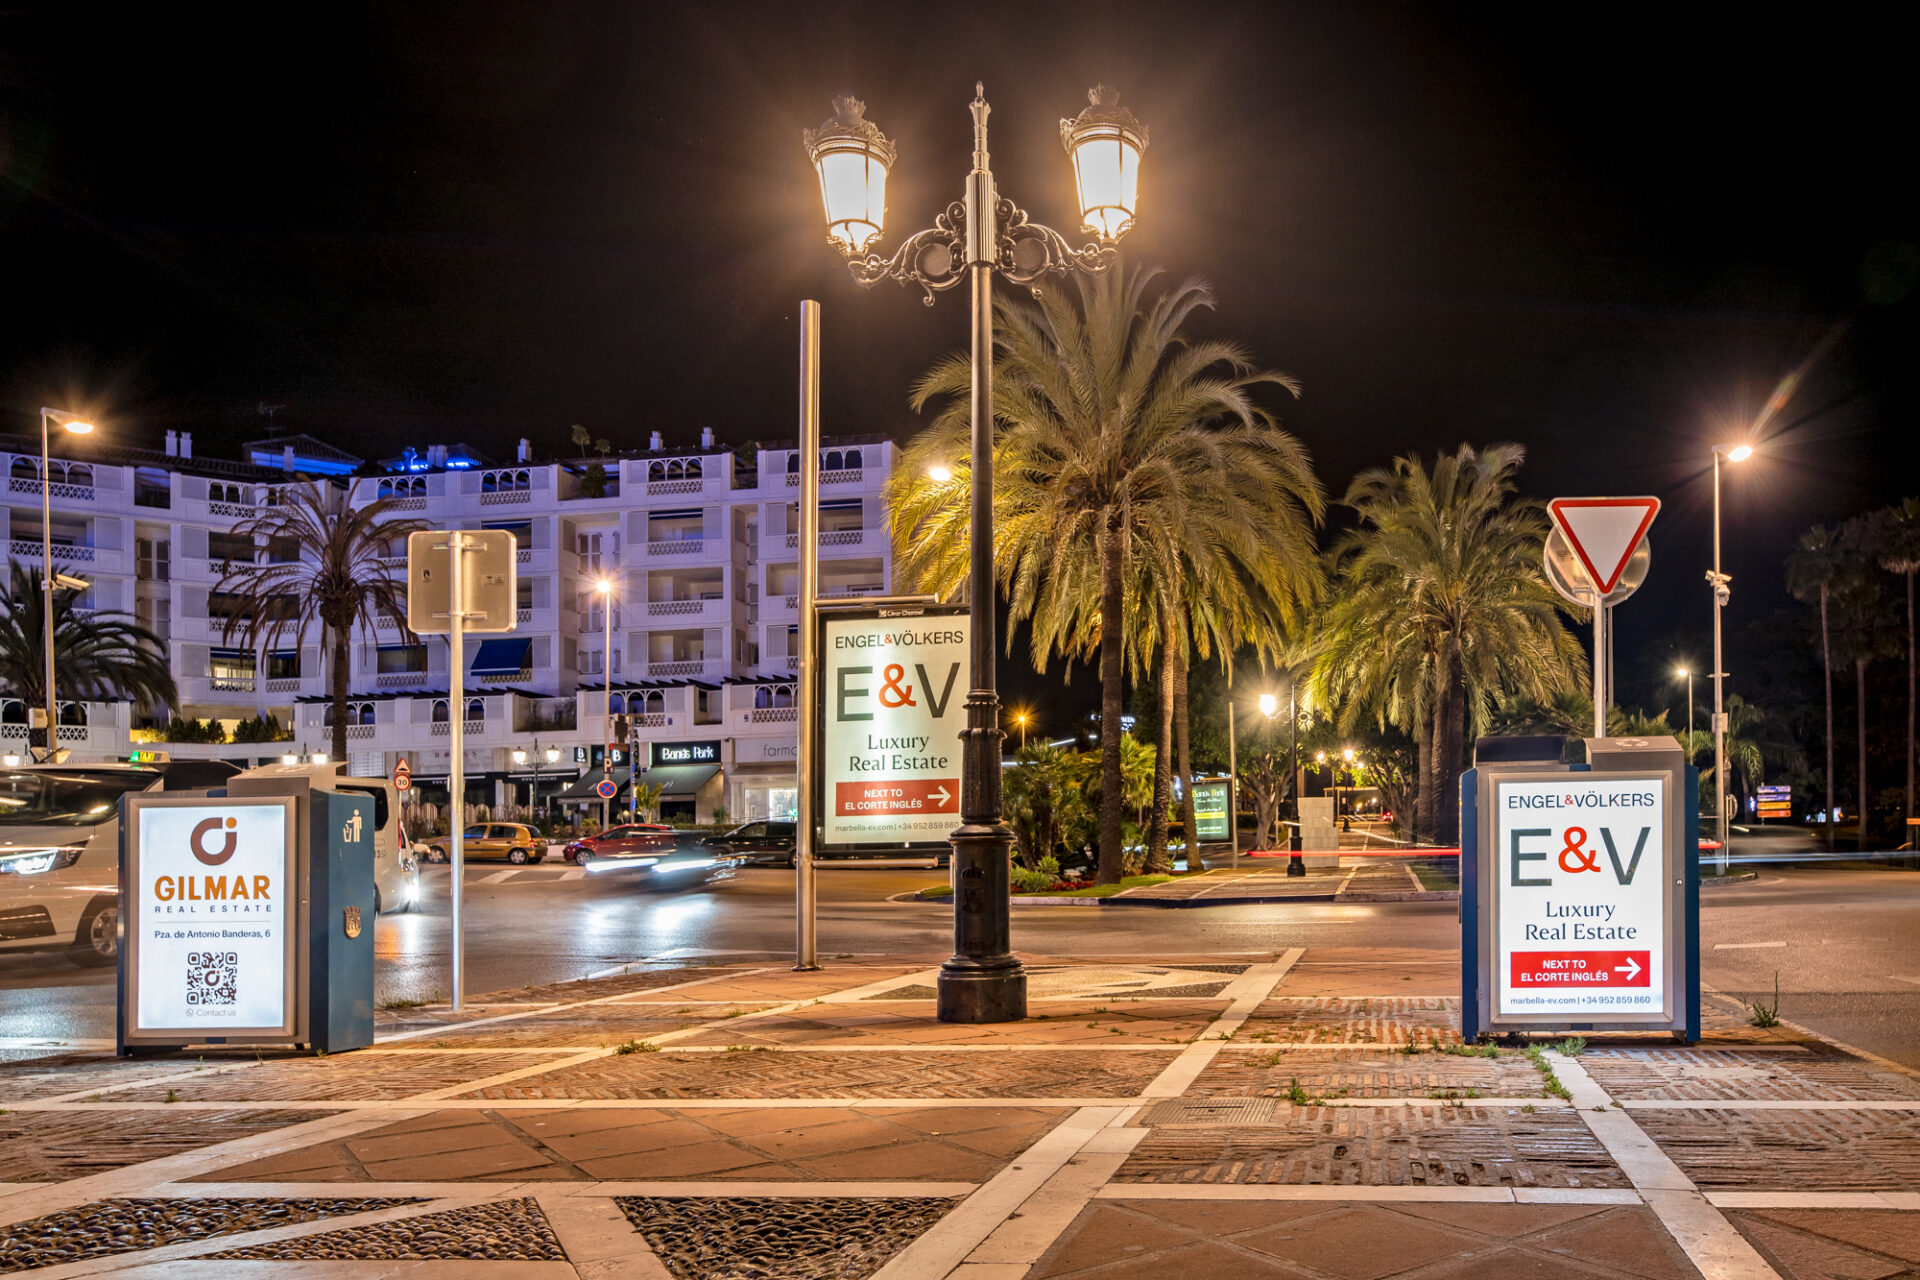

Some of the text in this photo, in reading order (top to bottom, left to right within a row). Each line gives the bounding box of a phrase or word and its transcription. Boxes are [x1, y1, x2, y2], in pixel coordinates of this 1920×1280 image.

[835, 630, 963, 649] ENGEL&VÖLKERS
[836, 661, 961, 722] E&V
[867, 734, 930, 753] Luxury
[139, 751, 155, 762] TAXI
[693, 745, 714, 759] Park
[849, 753, 949, 772] Real Estate
[397, 778, 408, 786] 30
[864, 788, 903, 798] NEXT TO
[1508, 790, 1655, 809] ENGEL&VÖLKERS
[845, 798, 923, 811] EL CORTE INGLÉS
[835, 823, 894, 832] marbella-ev.com
[913, 822, 927, 830] 952
[928, 821, 944, 830] 859
[944, 821, 959, 829] 860
[1510, 826, 1652, 887] E&V
[154, 875, 271, 901] GILMAR
[154, 904, 272, 914] REAL ESTATE
[1546, 901, 1616, 921] Luxury
[154, 929, 271, 939] Pza. de Antonio Banderas, 6
[1525, 920, 1637, 941] Real Estate
[1543, 959, 1587, 969] NEXT TO
[1521, 970, 1609, 982] EL CORTE INGLÉS
[1510, 996, 1577, 1005] marbella-ev.com
[1582, 996, 1598, 1005] +34
[1599, 996, 1615, 1005] 952
[1616, 996, 1632, 1005] 859
[1633, 995, 1651, 1004] 860
[196, 1007, 237, 1017] Contact us
